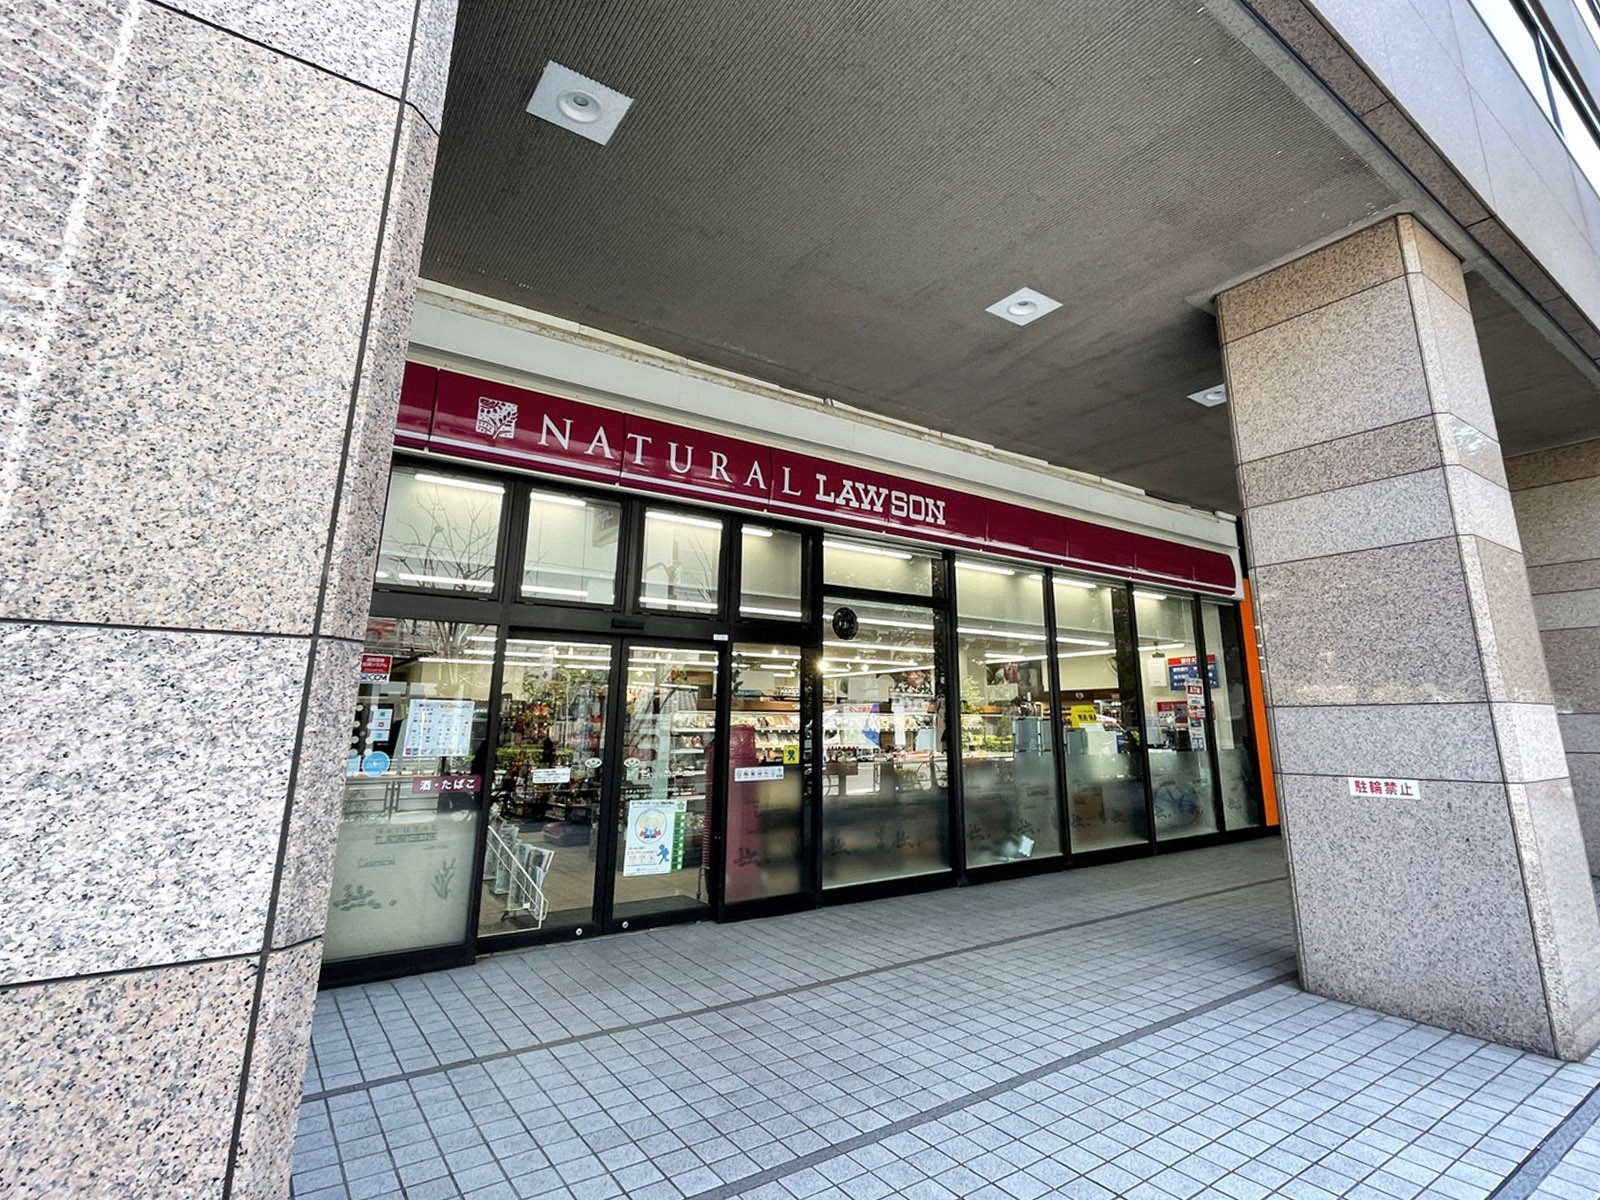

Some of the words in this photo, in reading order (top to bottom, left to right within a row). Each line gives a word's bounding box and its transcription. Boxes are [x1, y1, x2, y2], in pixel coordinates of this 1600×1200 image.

[537, 414, 801, 496] NATURAL
[815, 473, 946, 525] LAWSON
[420, 779, 475, 791] 酒・たばこ
[1354, 780, 1414, 796] 駐輪禁止
